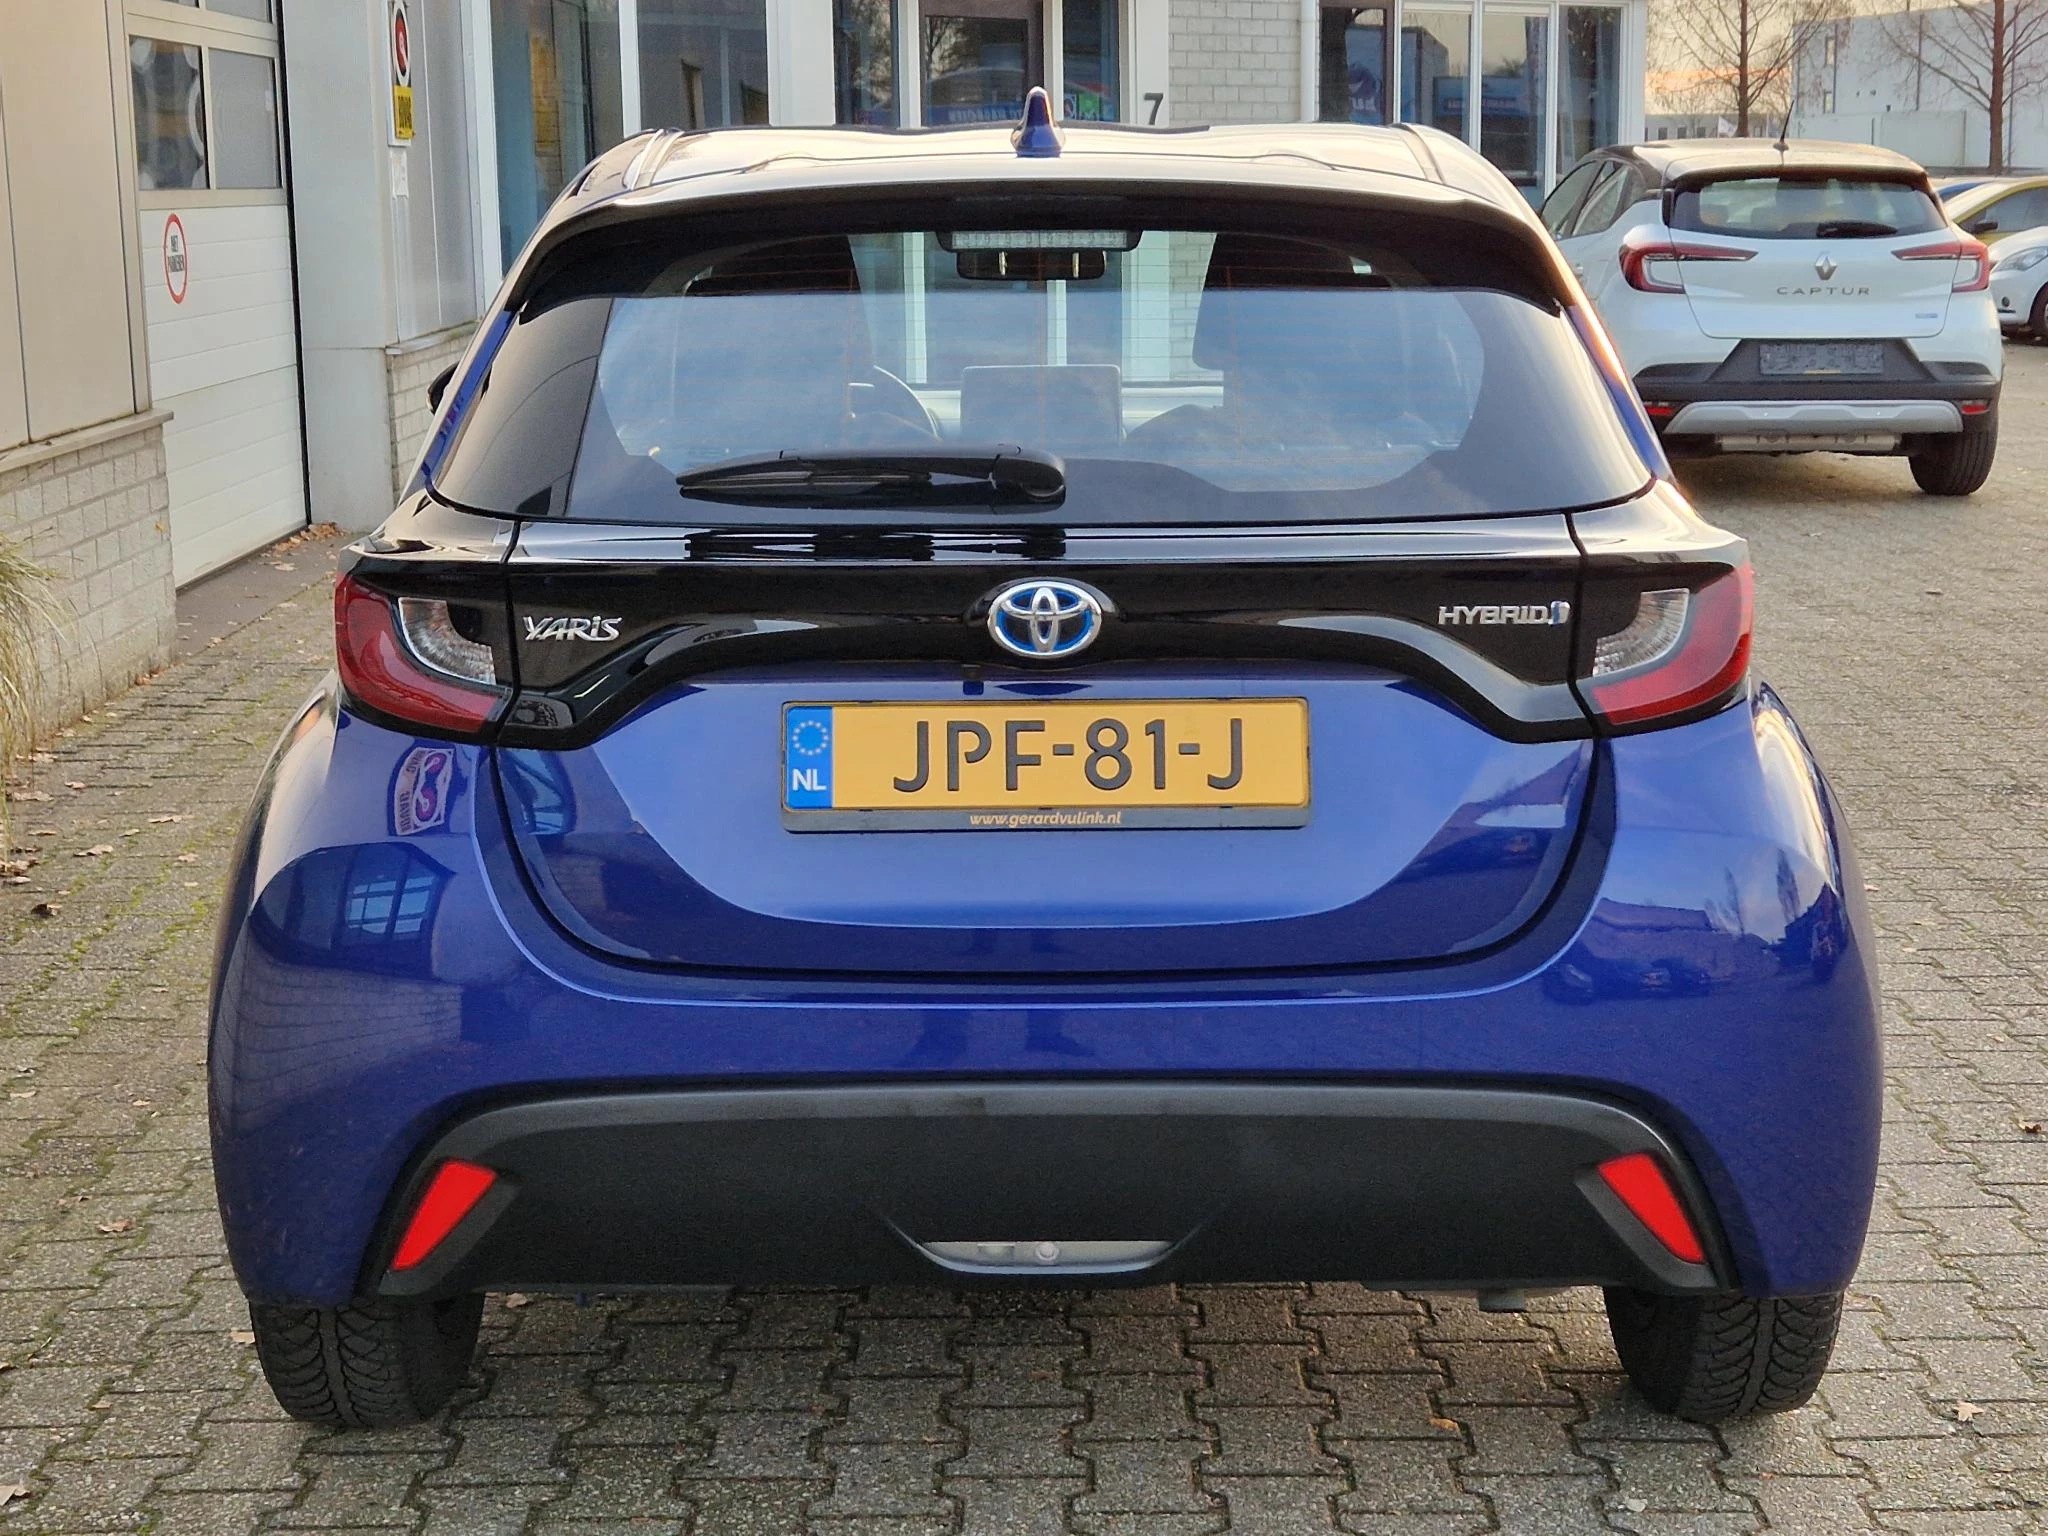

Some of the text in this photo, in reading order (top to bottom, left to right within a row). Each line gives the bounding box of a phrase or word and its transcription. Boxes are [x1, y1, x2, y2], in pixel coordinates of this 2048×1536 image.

[1143, 93, 1164, 125] 7
[1776, 286, 1870, 296] CAPTUR
[1438, 606, 1549, 624] HYBRID
[523, 616, 622, 641] YARIS
[893, 717, 1243, 793] JPF-81-J
[792, 769, 827, 792] NL
[970, 811, 1121, 828] www.gerardvulink.nl
